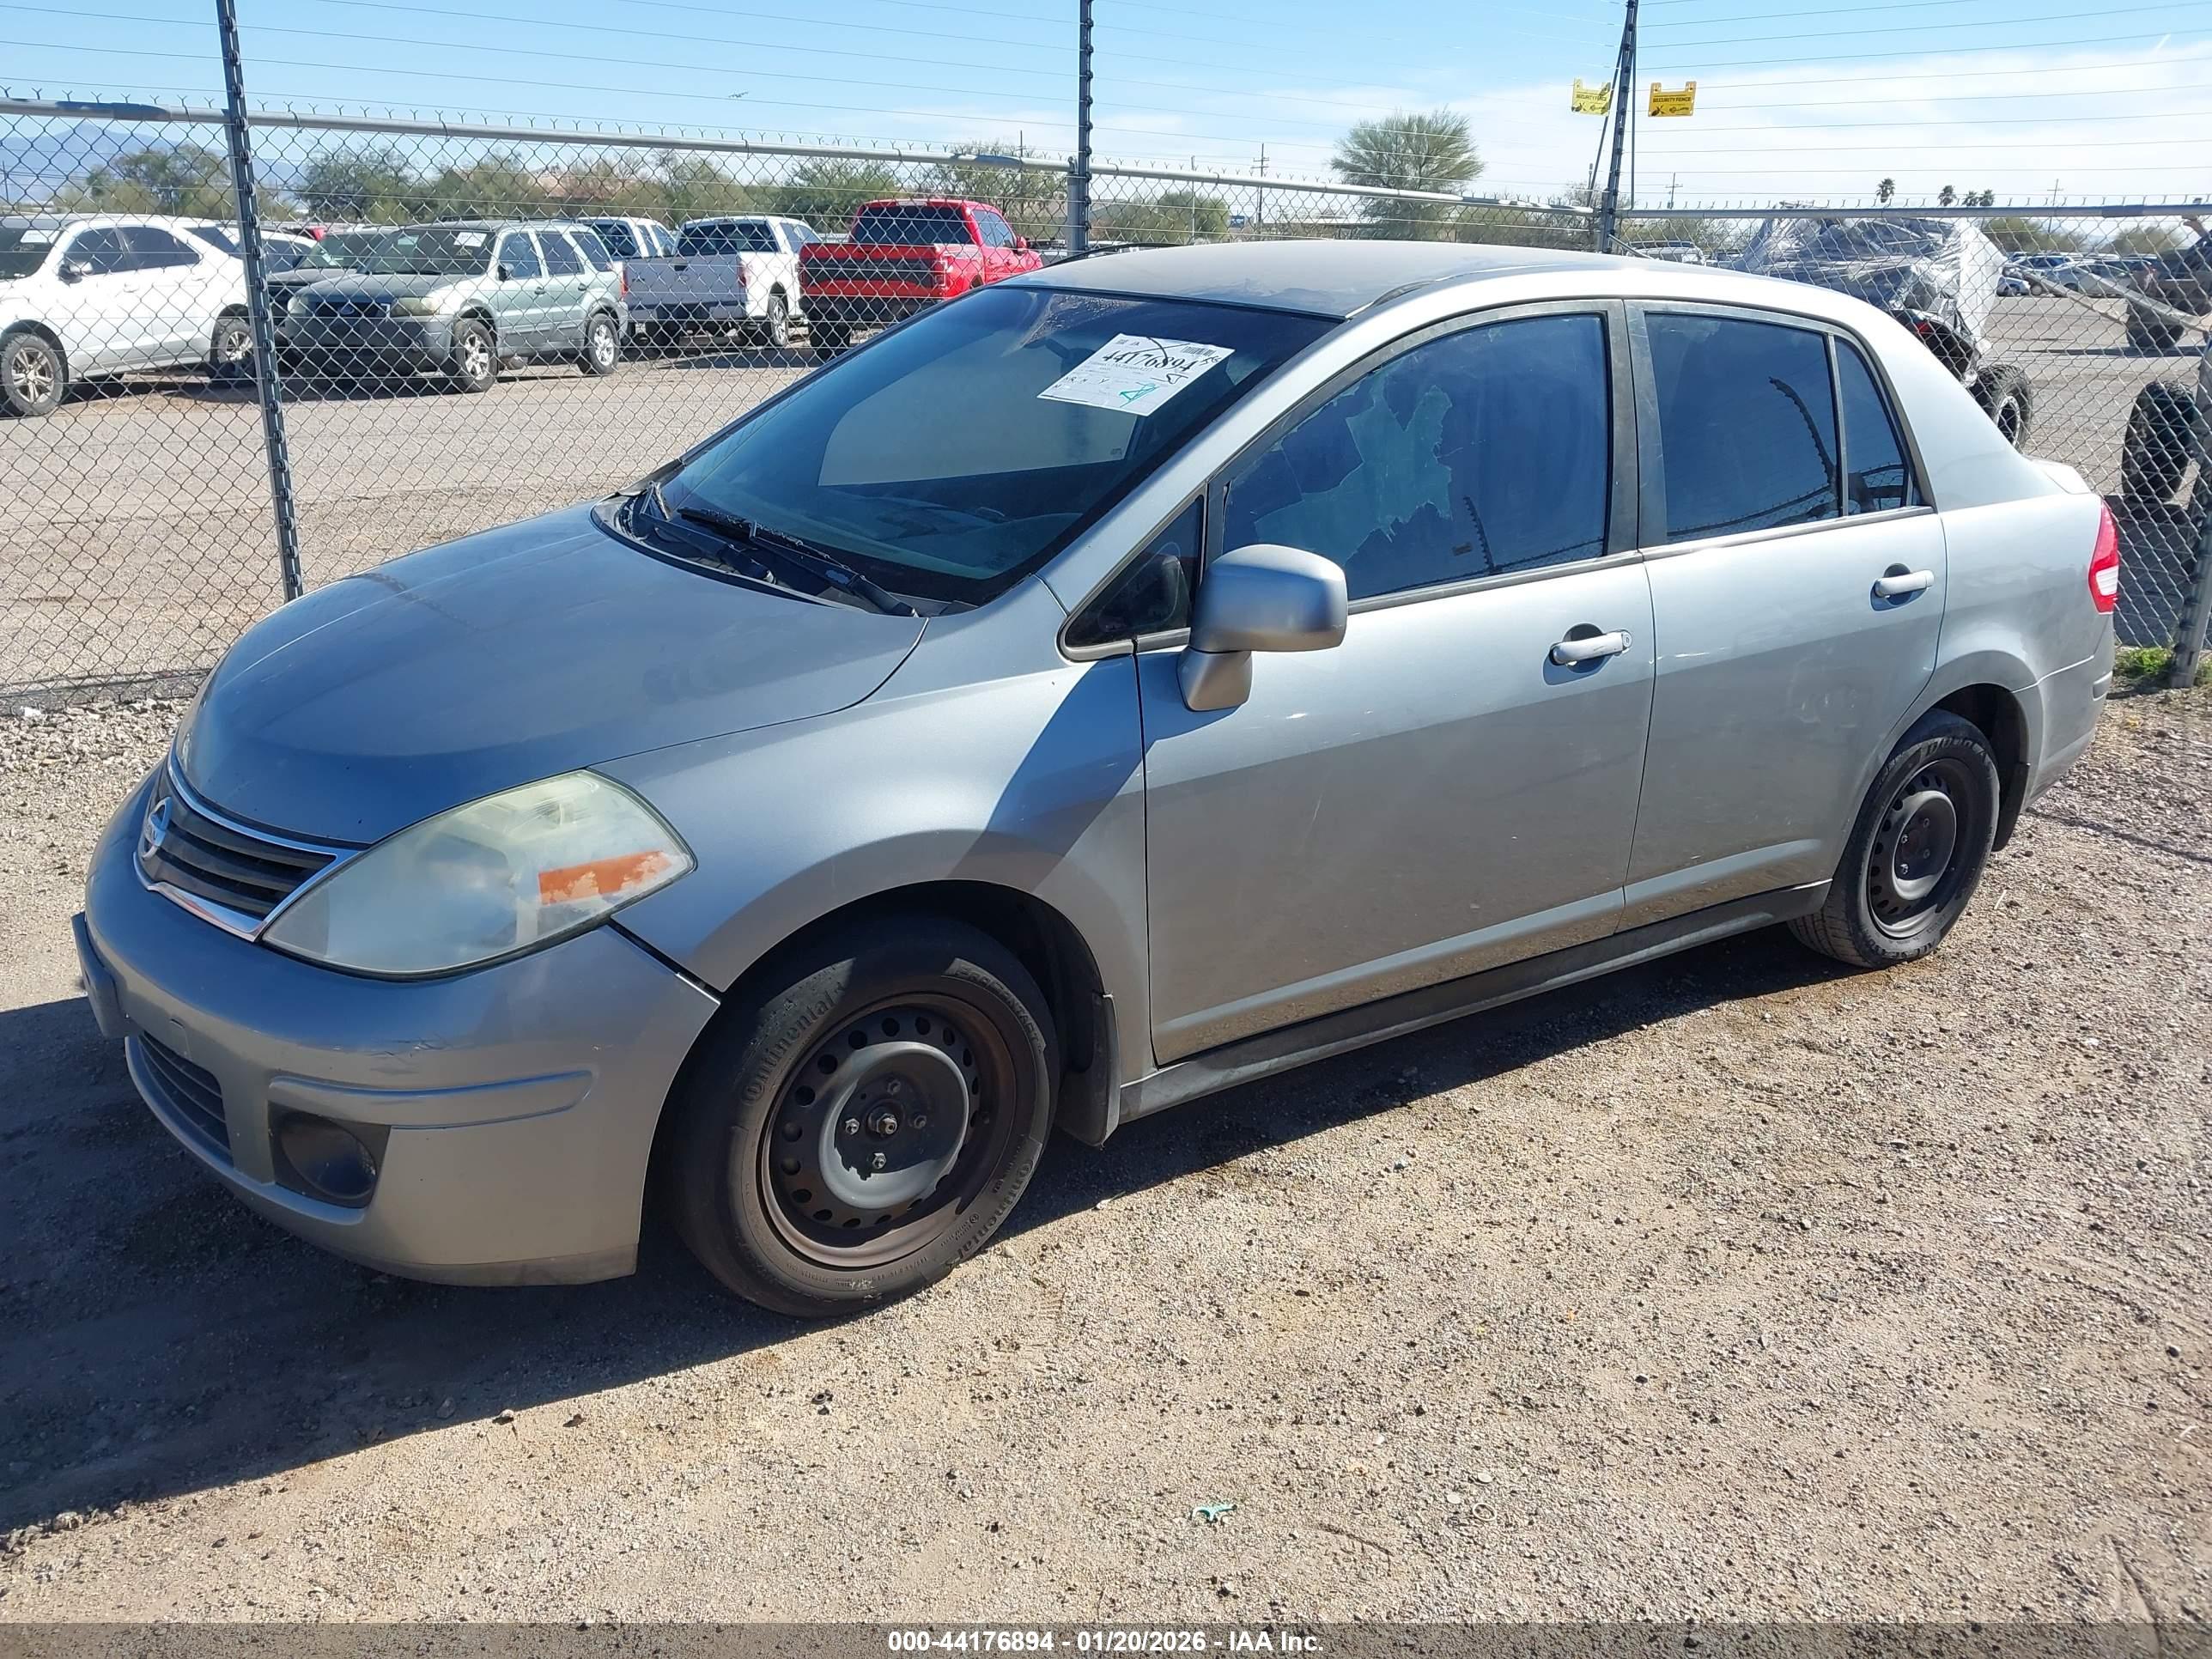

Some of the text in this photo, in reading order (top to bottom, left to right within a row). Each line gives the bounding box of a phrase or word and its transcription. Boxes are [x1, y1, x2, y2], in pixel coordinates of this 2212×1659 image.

[1101, 349, 1199, 372] 44176894
[740, 989, 836, 1105] Continental
[958, 1159, 1034, 1259] Continental
